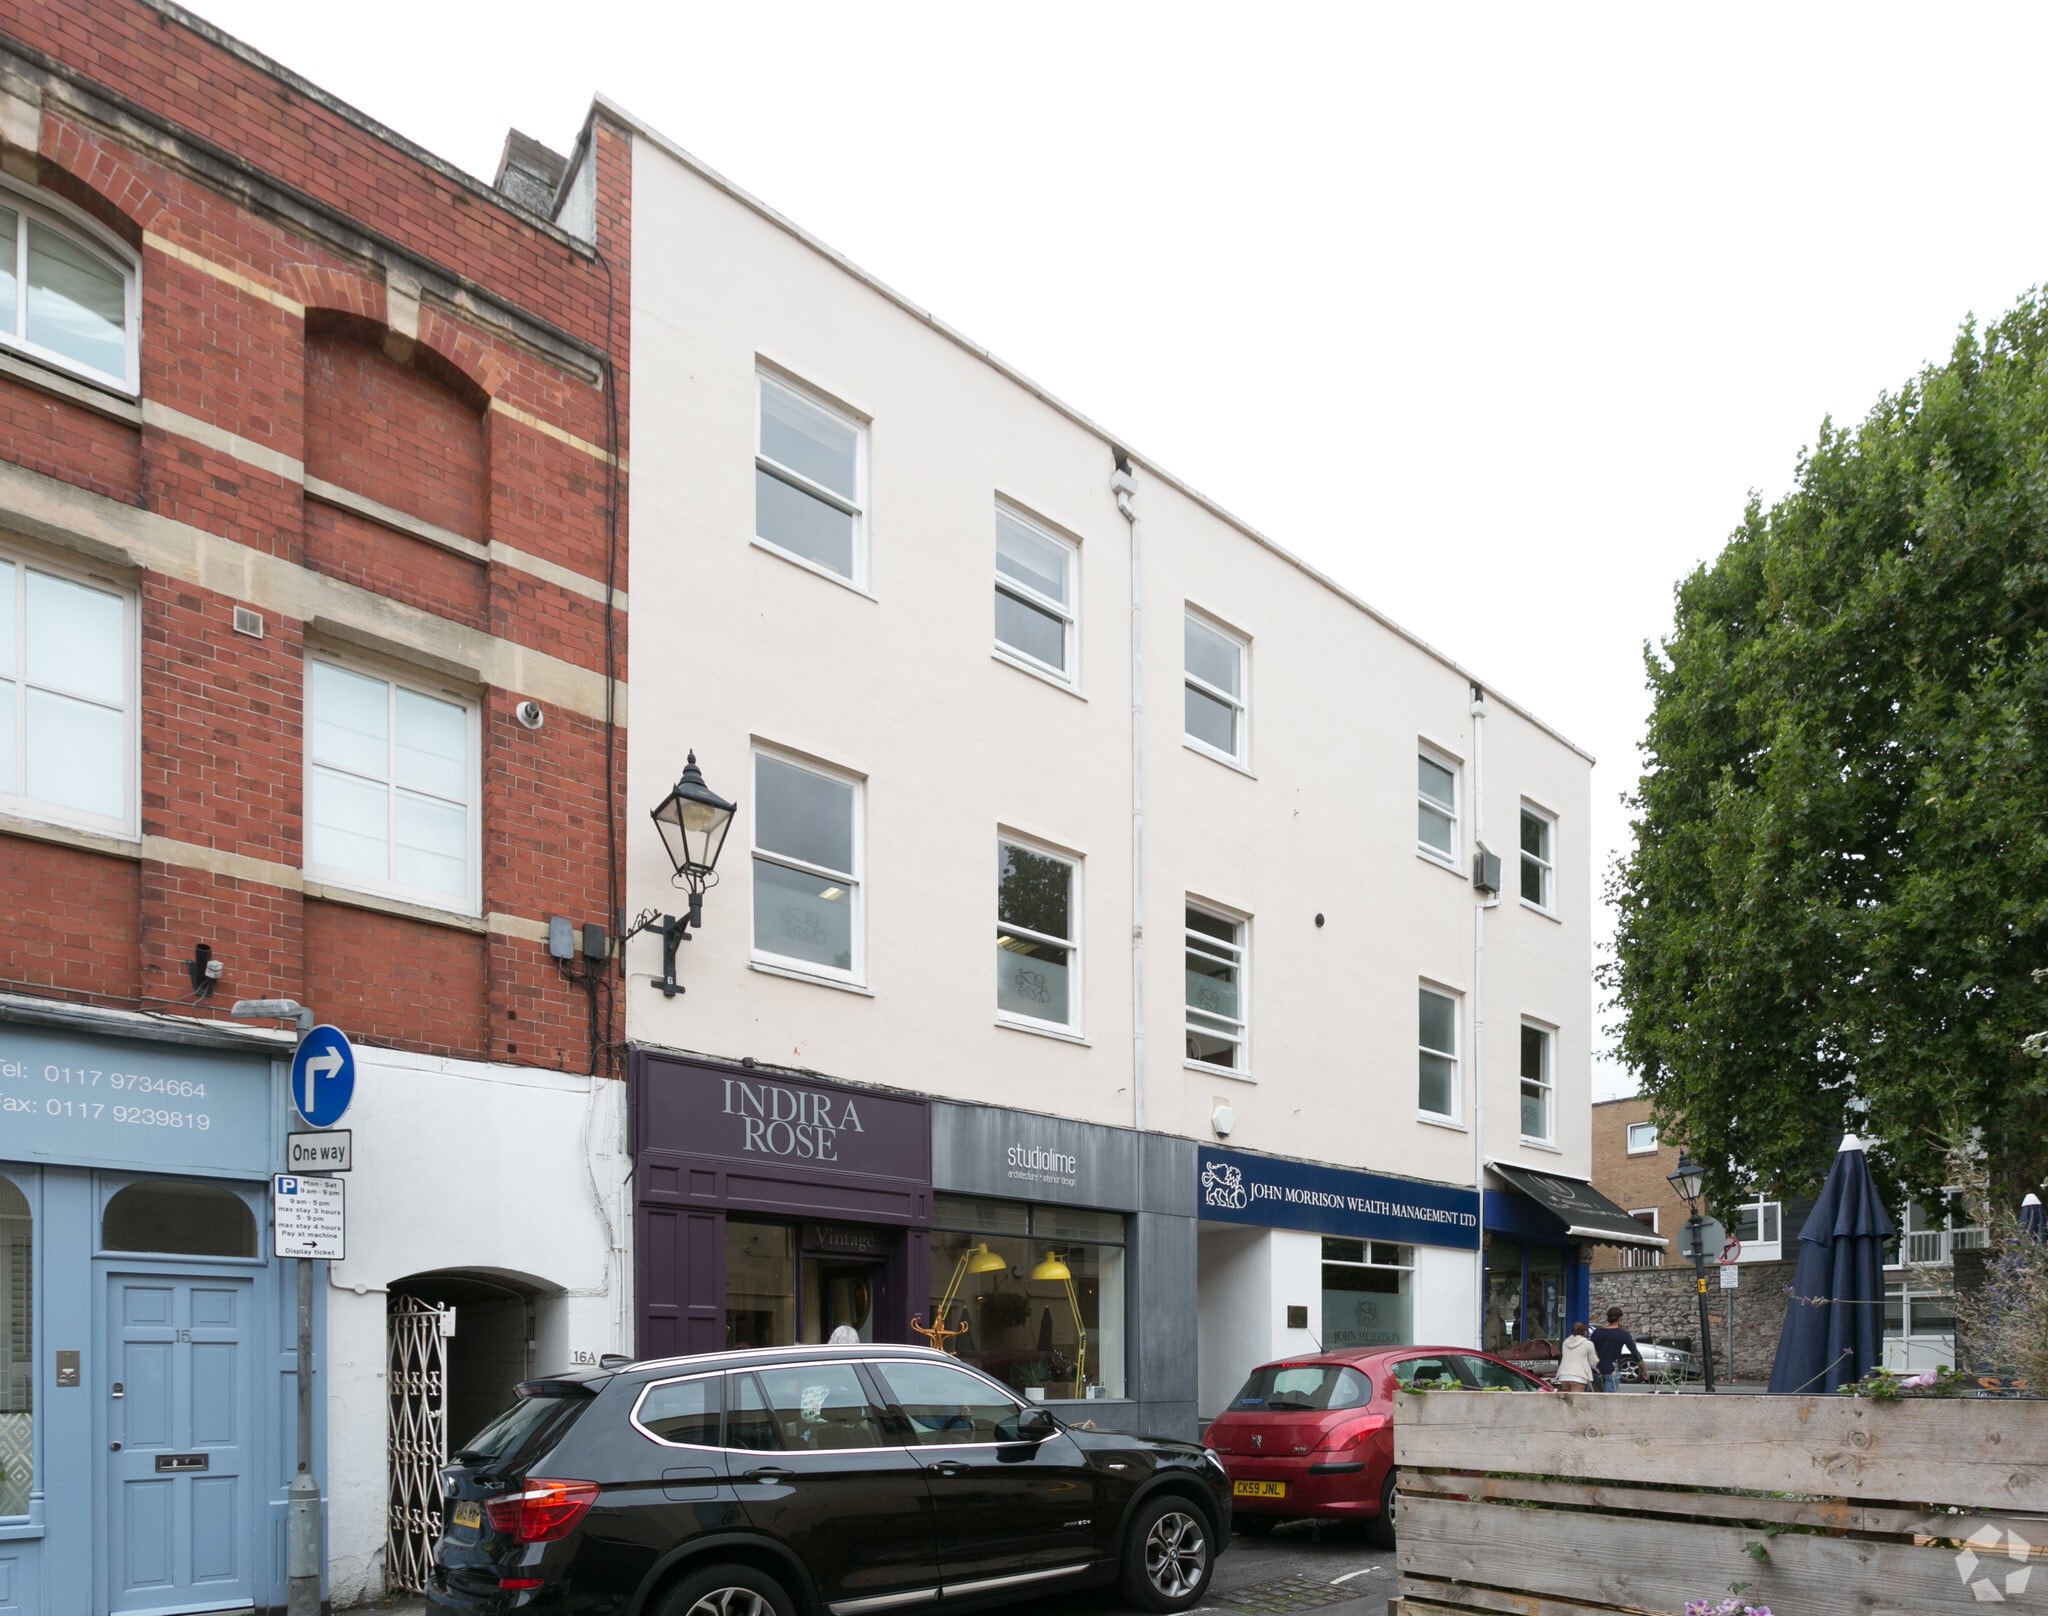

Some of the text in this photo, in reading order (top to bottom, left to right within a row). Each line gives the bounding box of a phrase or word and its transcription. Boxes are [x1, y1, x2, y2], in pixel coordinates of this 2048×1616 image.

[44, 1065, 103, 1087] 0117
[110, 1073, 207, 1099] 9734664
[0, 1093, 211, 1131] ax: 0117 9239819
[721, 1078, 865, 1133] INDIRA
[742, 1115, 838, 1162] ROSE
[293, 1144, 345, 1163] One way
[1007, 1142, 1076, 1174] studiolime
[1061, 1176, 1077, 1187] design
[320, 1208, 341, 1216] hours
[1249, 1182, 1477, 1227] JOHN MORRISON WEALTH MANAGEMENT LTD
[307, 1231, 338, 1239] machine
[815, 1226, 875, 1251] Vintage
[285, 1247, 335, 1256] Display ticket
[175, 1329, 191, 1343] 15
[1334, 1331, 1400, 1343] JOHN MORRISON
[573, 1350, 596, 1362] 16A
[1237, 1482, 1280, 1495] CK59 JNL
